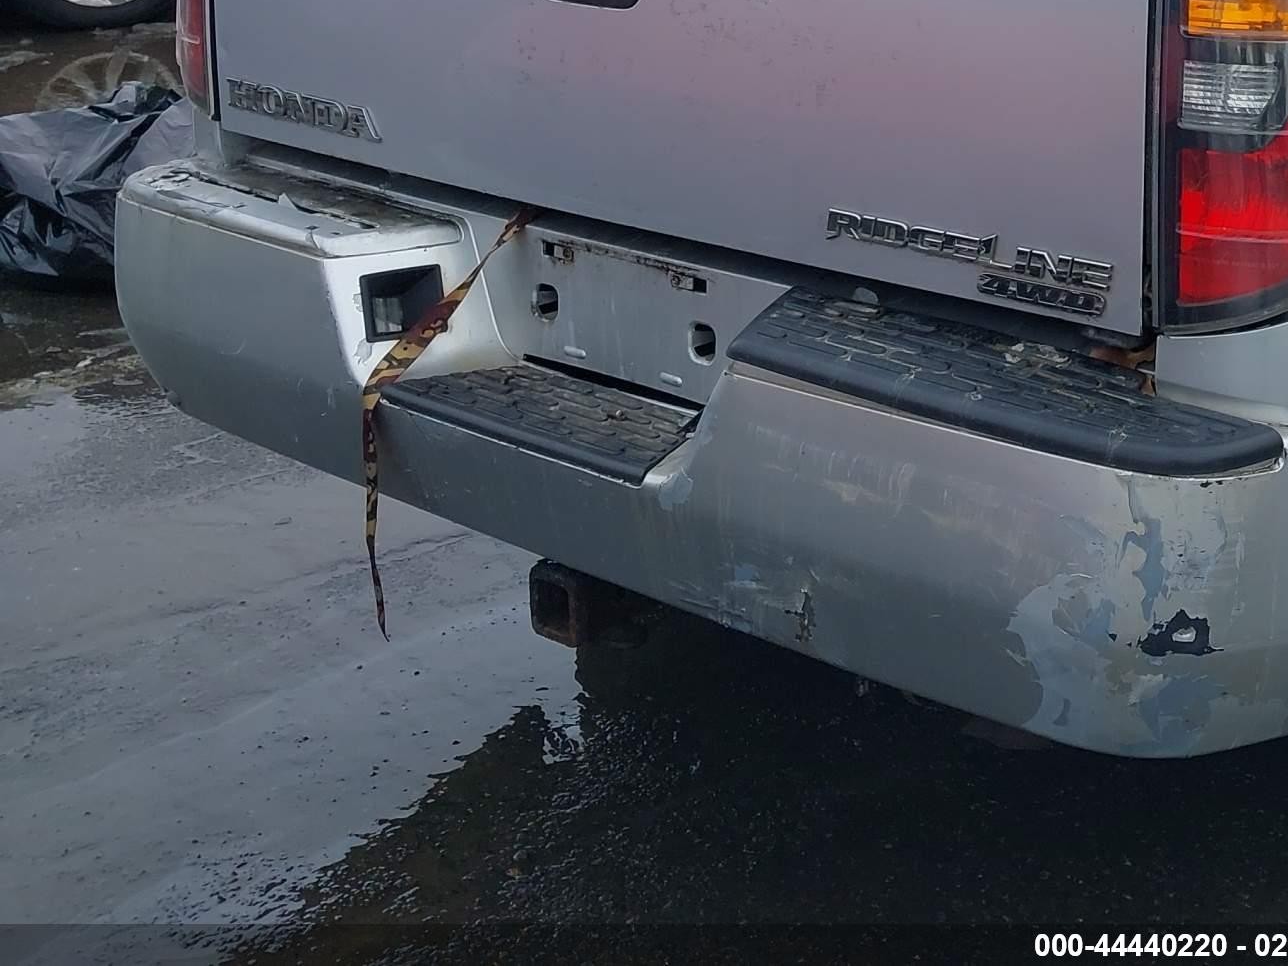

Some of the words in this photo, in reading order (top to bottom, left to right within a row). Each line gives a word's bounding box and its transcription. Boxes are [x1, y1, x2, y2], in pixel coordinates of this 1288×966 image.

[227, 77, 383, 143] HONDA
[826, 207, 1114, 290] RIDGELINE
[976, 272, 1108, 317] 4WD
